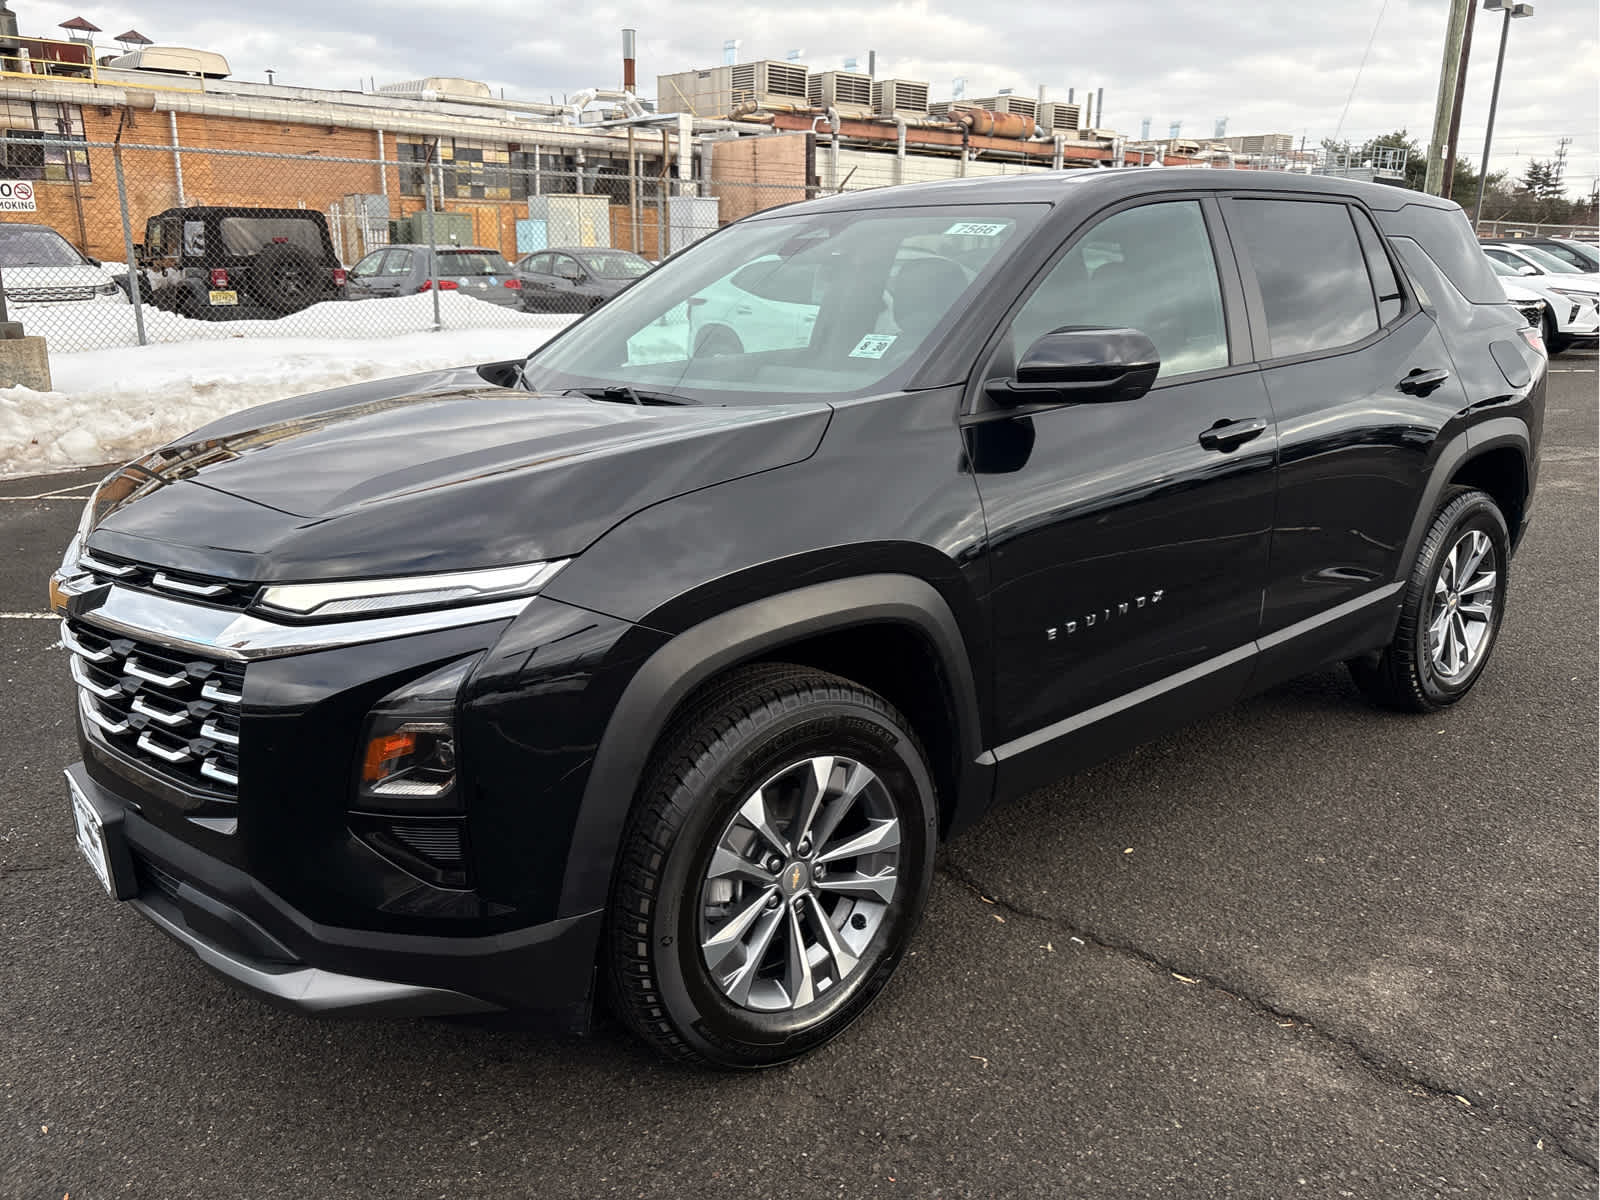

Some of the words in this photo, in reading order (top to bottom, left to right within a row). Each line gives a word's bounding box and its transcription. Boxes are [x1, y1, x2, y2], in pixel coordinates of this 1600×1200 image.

[0, 183, 12, 197] O
[0, 201, 35, 210] MOKING
[954, 224, 998, 235] 7566
[1046, 589, 1164, 640] EQUINOX
